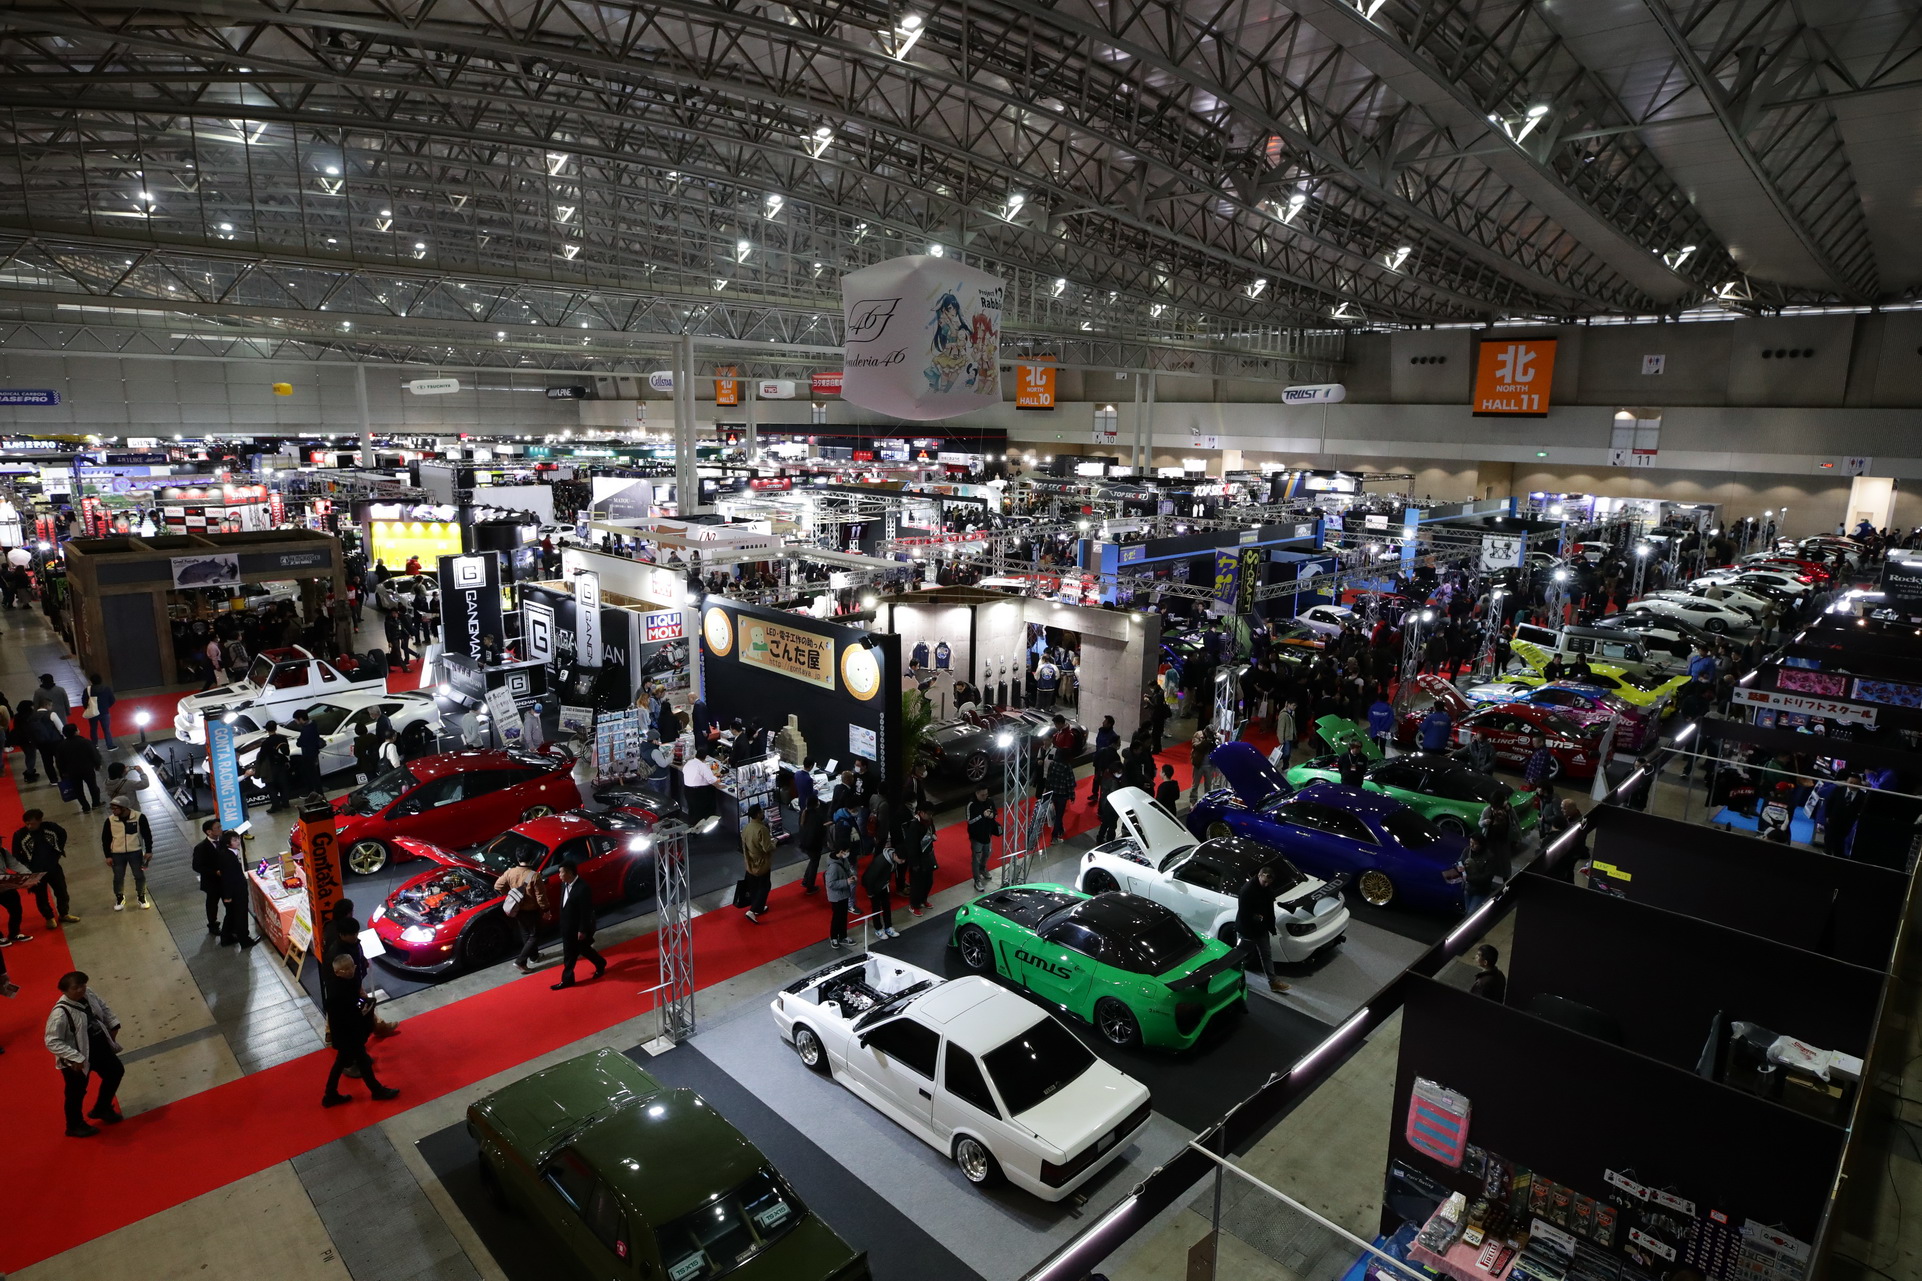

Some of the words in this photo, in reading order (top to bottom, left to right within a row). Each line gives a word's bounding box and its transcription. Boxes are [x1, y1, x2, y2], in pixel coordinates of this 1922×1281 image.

[1495, 345, 1537, 383] 北
[1020, 397, 1039, 405] HALL
[1039, 393, 1051, 405] 10
[1284, 389, 1322, 400] TRUST
[1482, 399, 1519, 410] HALL
[1521, 394, 1539, 410] 11
[1106, 436, 1115, 444] 10
[1637, 455, 1650, 466] 11
[1032, 482, 1048, 491] TOP
[1113, 490, 1126, 498] TOP
[1193, 485, 1212, 498] TOP
[646, 613, 681, 629] LIQUI
[647, 626, 682, 641] MOLY
[770, 639, 821, 671] ごんた屋
[213, 727, 232, 761] GONTA
[219, 762, 235, 796] RACING
[222, 796, 239, 822] TEAM
[1480, 1242, 1498, 1268] PIRELLI
